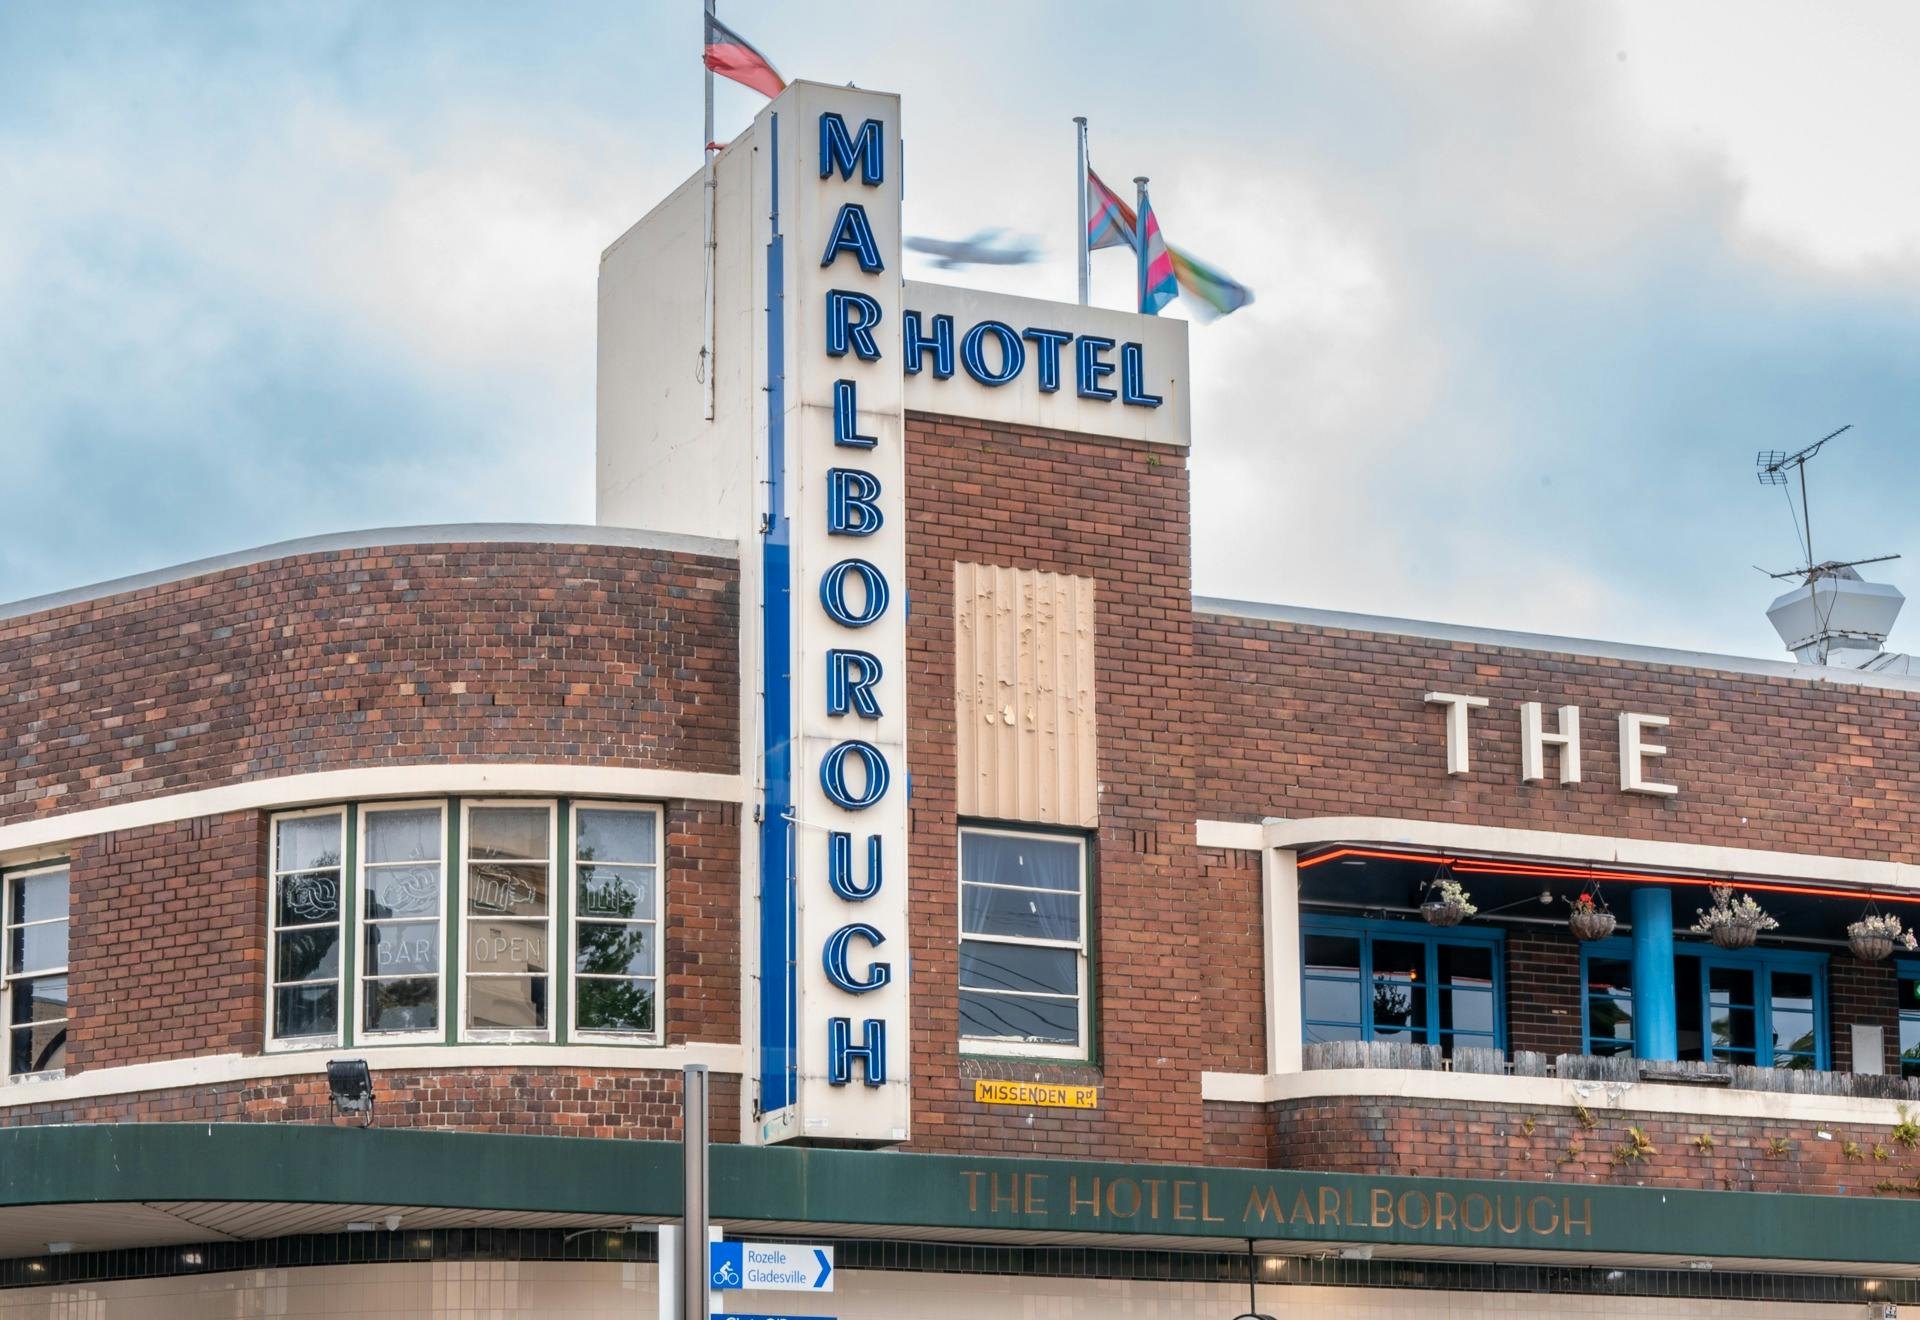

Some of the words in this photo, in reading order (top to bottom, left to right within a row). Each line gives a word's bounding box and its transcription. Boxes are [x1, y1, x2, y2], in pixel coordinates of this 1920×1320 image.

[903, 309, 1163, 408] HOTEL
[819, 111, 890, 1086] MARLBOROUGH
[1424, 691, 1678, 796] THE
[377, 938, 430, 965] BAR
[475, 937, 541, 962] OPEN
[981, 1084, 1067, 1104] MISSENDEN
[959, 1171, 1049, 1214] THE
[1069, 1175, 1225, 1223] HOTEL
[1242, 1184, 1593, 1237] MARLBOROUGH
[748, 1250, 787, 1264] Rozelle
[748, 1269, 807, 1284] Gladesville
